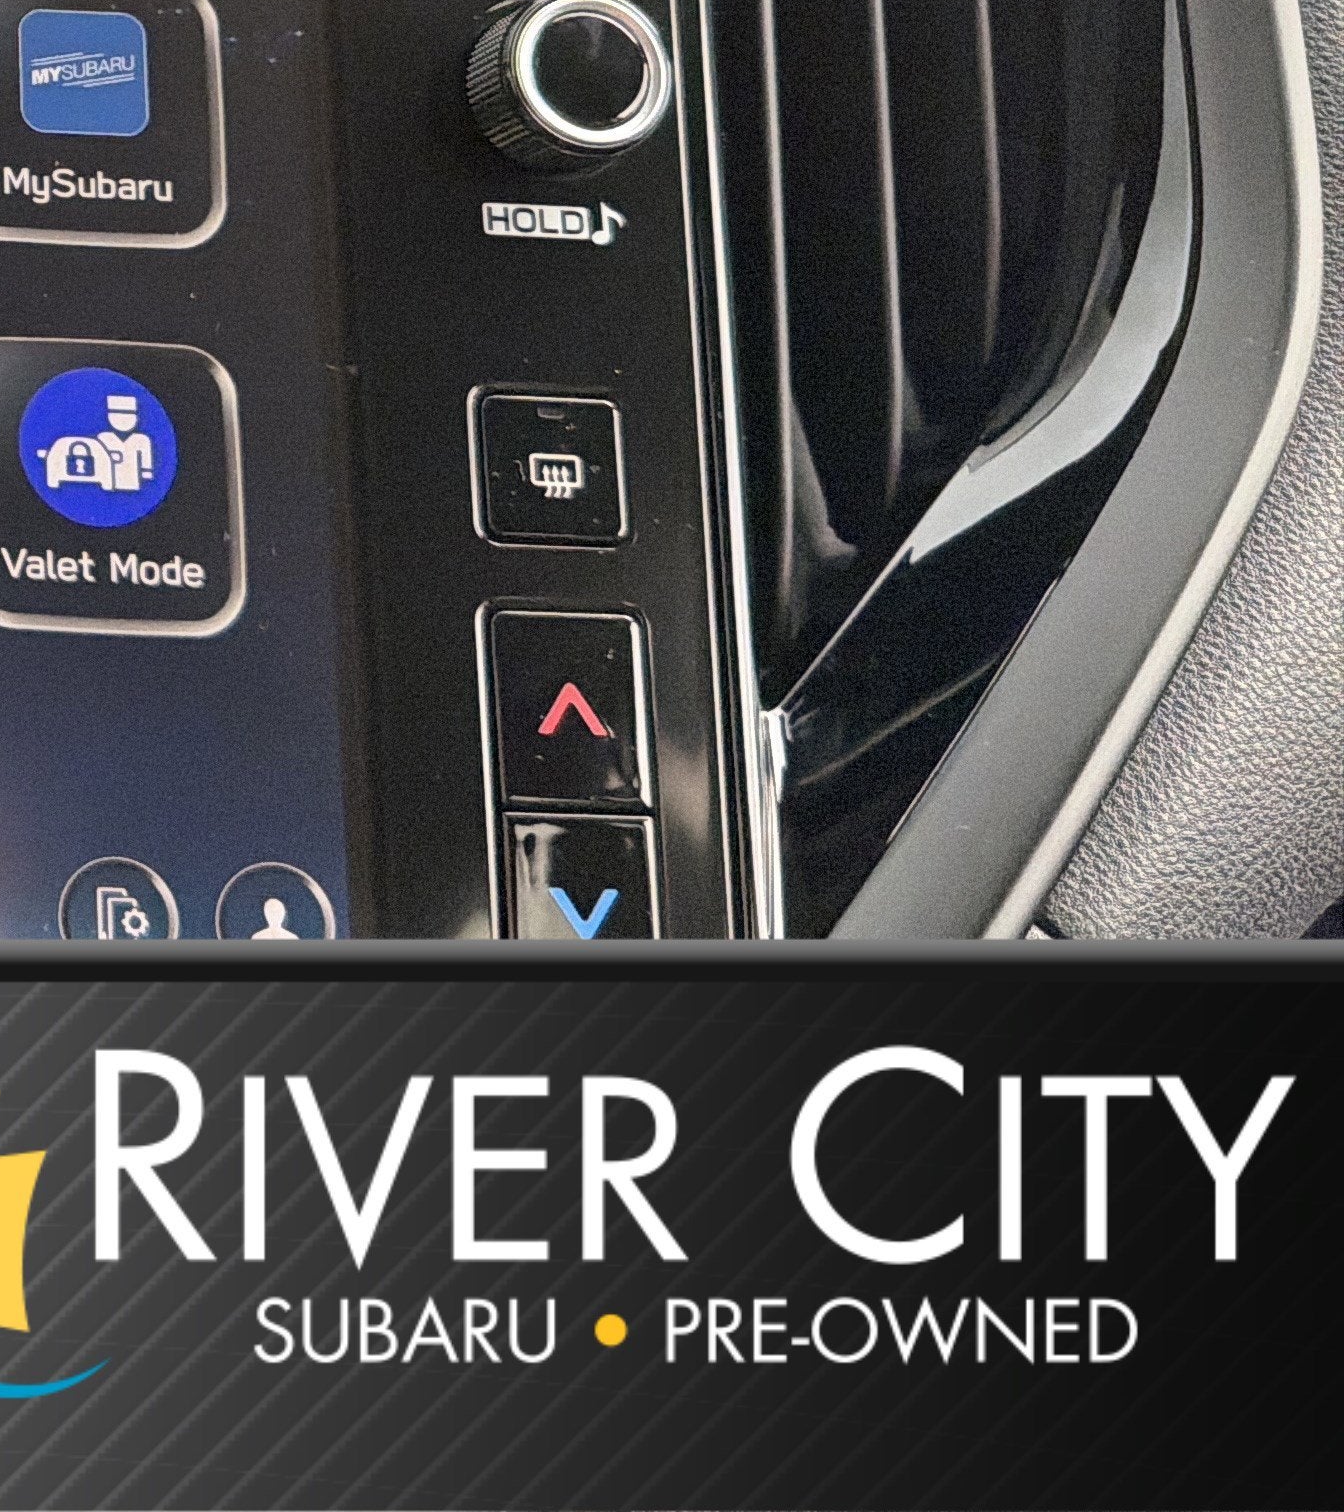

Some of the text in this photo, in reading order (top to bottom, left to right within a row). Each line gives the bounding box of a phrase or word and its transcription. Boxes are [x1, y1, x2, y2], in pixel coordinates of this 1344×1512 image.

[30, 53, 136, 86] MYSUBARU
[2, 166, 174, 204] MySubaru
[486, 206, 585, 235] HOLD
[0, 546, 206, 589] Valet Mode
